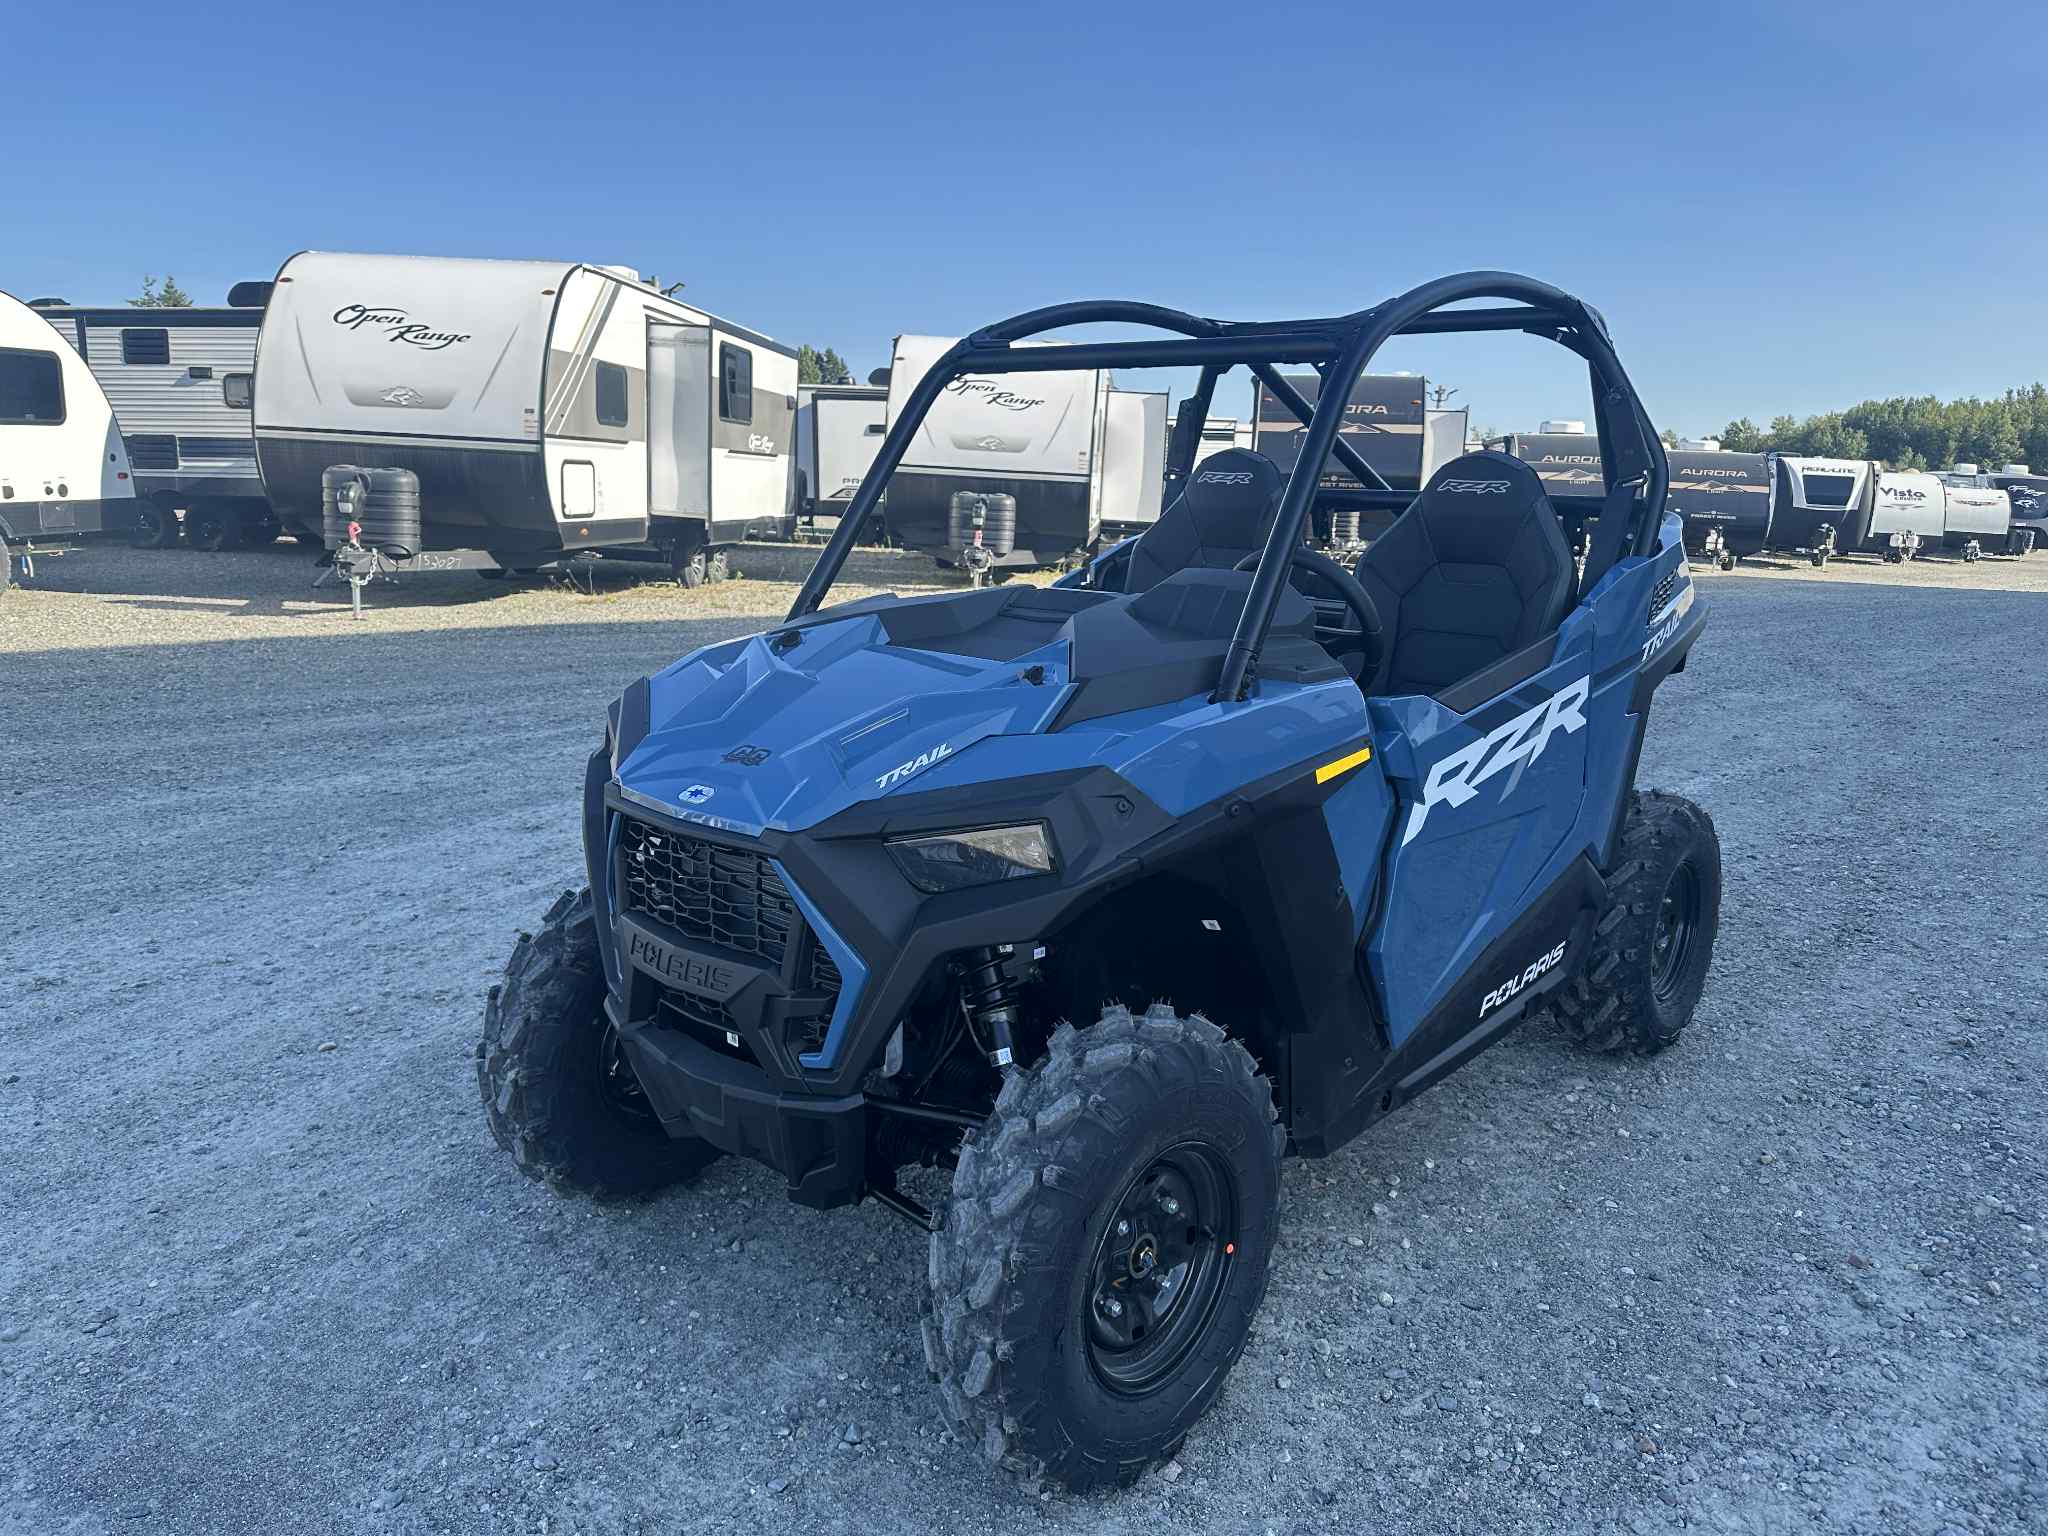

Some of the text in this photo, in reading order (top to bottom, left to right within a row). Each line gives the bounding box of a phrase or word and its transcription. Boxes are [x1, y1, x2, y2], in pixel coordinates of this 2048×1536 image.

[332, 304, 471, 350] Open Range
[983, 391, 1046, 411] Range
[1541, 455, 1602, 465] AURO
[1680, 468, 1748, 478] AURORA
[1197, 471, 1254, 485] RZR
[1437, 478, 1511, 494] RZR
[1880, 487, 1927, 498] Vista
[1642, 609, 1680, 662] TRAIL
[875, 744, 952, 789] TRAIL
[1401, 674, 1590, 848] RZR
[630, 932, 735, 994] POLARIS
[1479, 940, 1566, 1018] POLARIS
